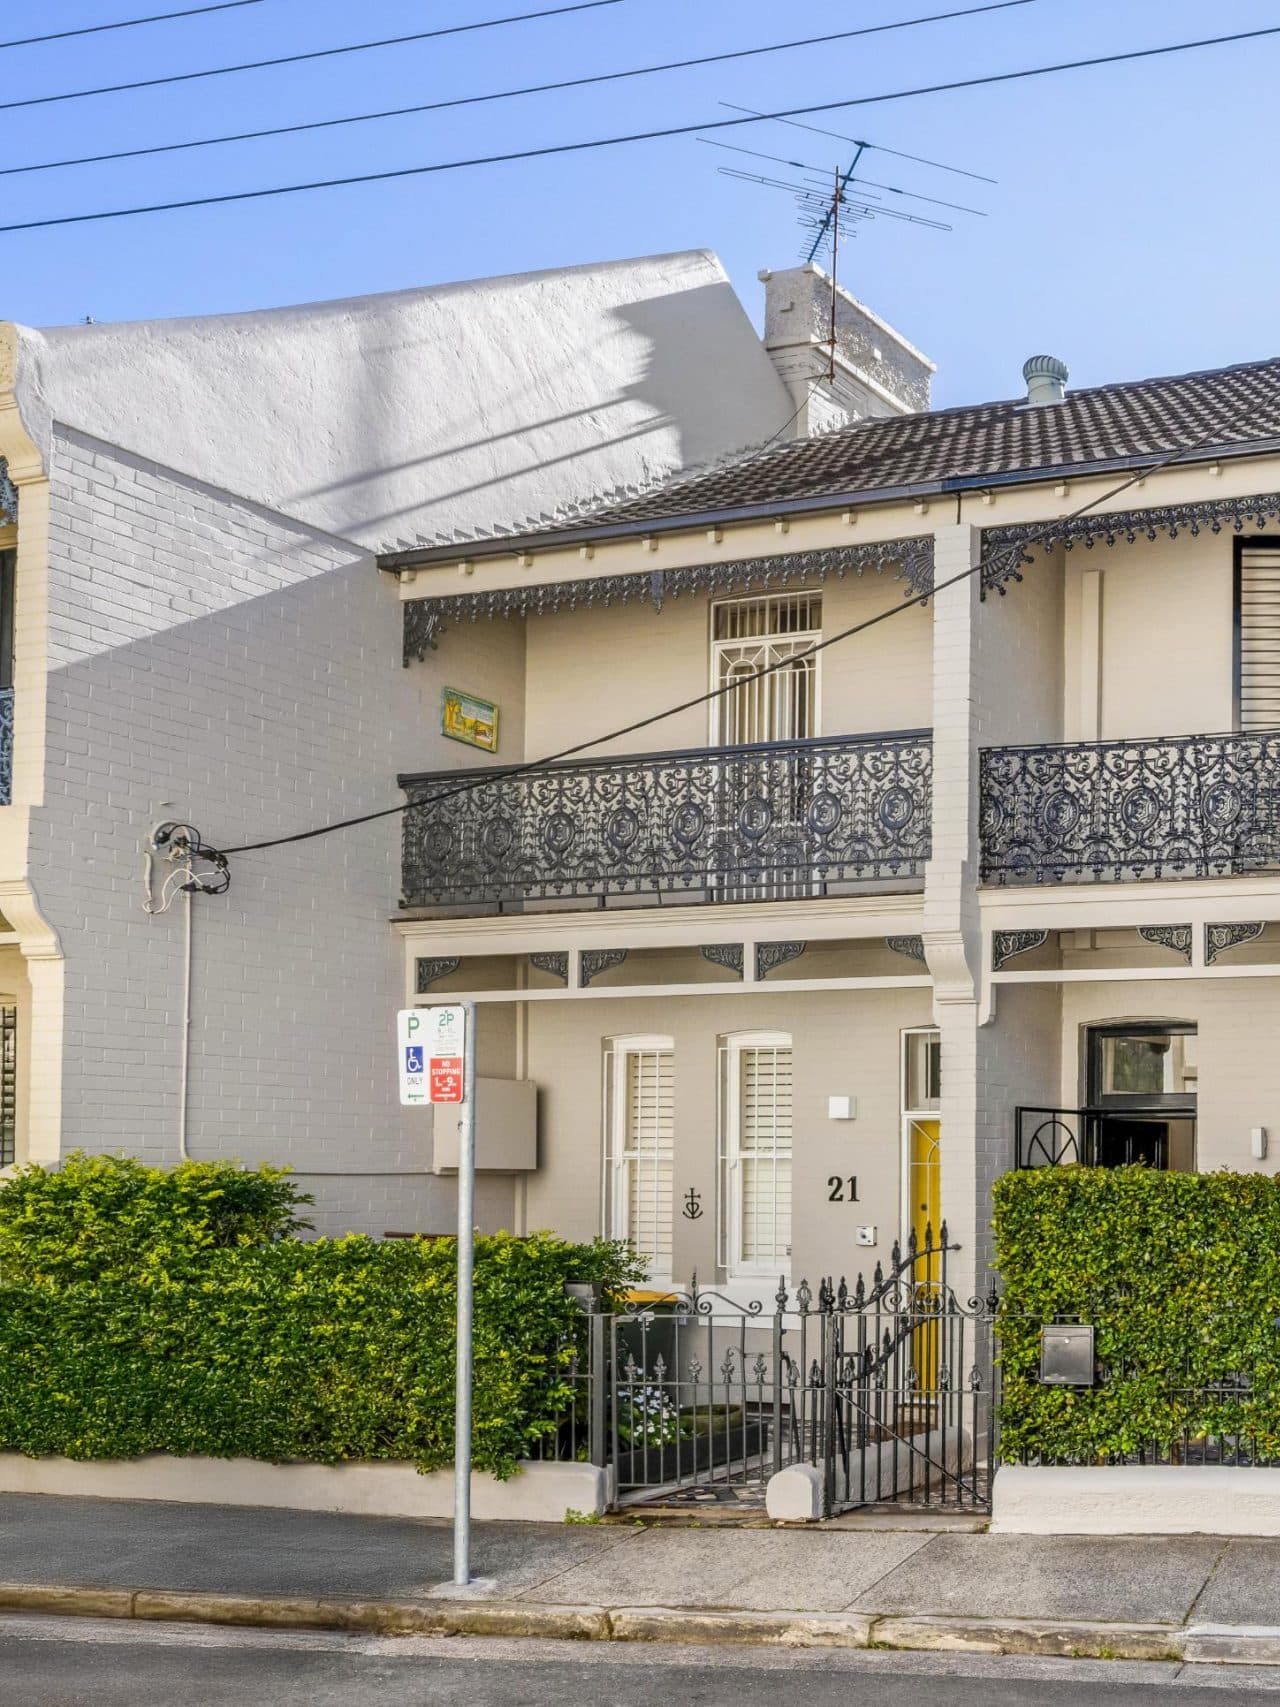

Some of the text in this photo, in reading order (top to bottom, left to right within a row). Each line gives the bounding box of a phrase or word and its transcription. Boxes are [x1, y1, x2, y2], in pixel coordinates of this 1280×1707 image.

[438, 1014, 455, 1026] 2P
[408, 1016, 420, 1039] P
[441, 1060, 451, 1068] NO
[431, 1067, 461, 1076] STOPPING
[407, 1076, 423, 1085] ONLY
[827, 1175, 861, 1202] 21
